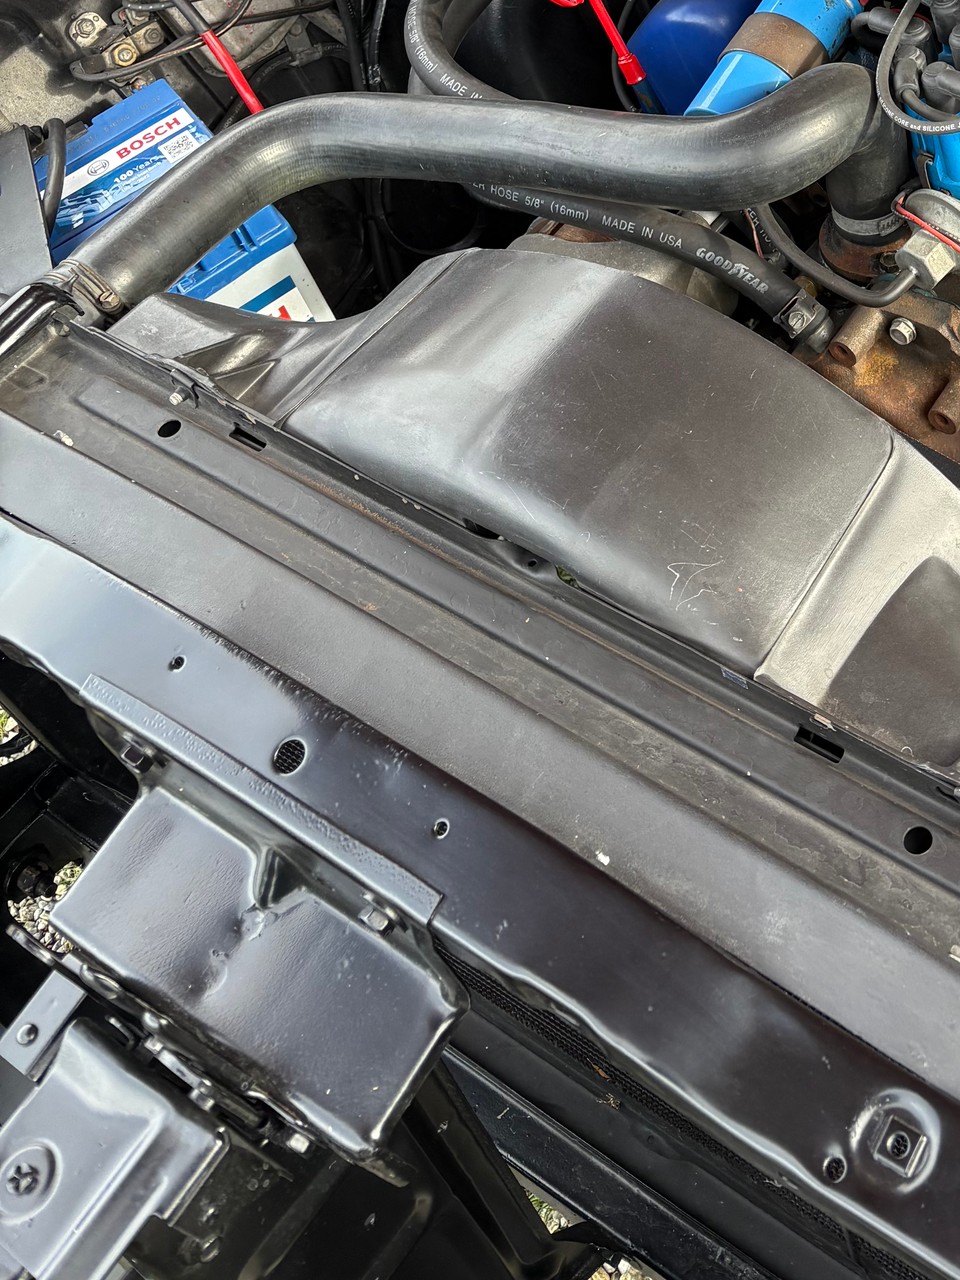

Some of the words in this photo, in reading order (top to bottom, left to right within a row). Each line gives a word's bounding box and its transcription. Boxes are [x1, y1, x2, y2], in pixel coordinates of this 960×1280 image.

[407, 4, 418, 30] HOSE
[414, 44, 439, 73] (16mm)
[439, 73, 468, 97] MADE
[116, 117, 182, 159] BOSCH
[894, 115, 910, 128] CORE
[922, 123, 955, 132] SILICONE
[113, 169, 134, 183] 100
[490, 183, 519, 204] HOSE
[550, 199, 590, 222] (16mm)
[601, 214, 635, 235] MADE
[640, 225, 655, 240] IN
[658, 231, 684, 250] USA
[695, 246, 770, 296] GOODYEAR
